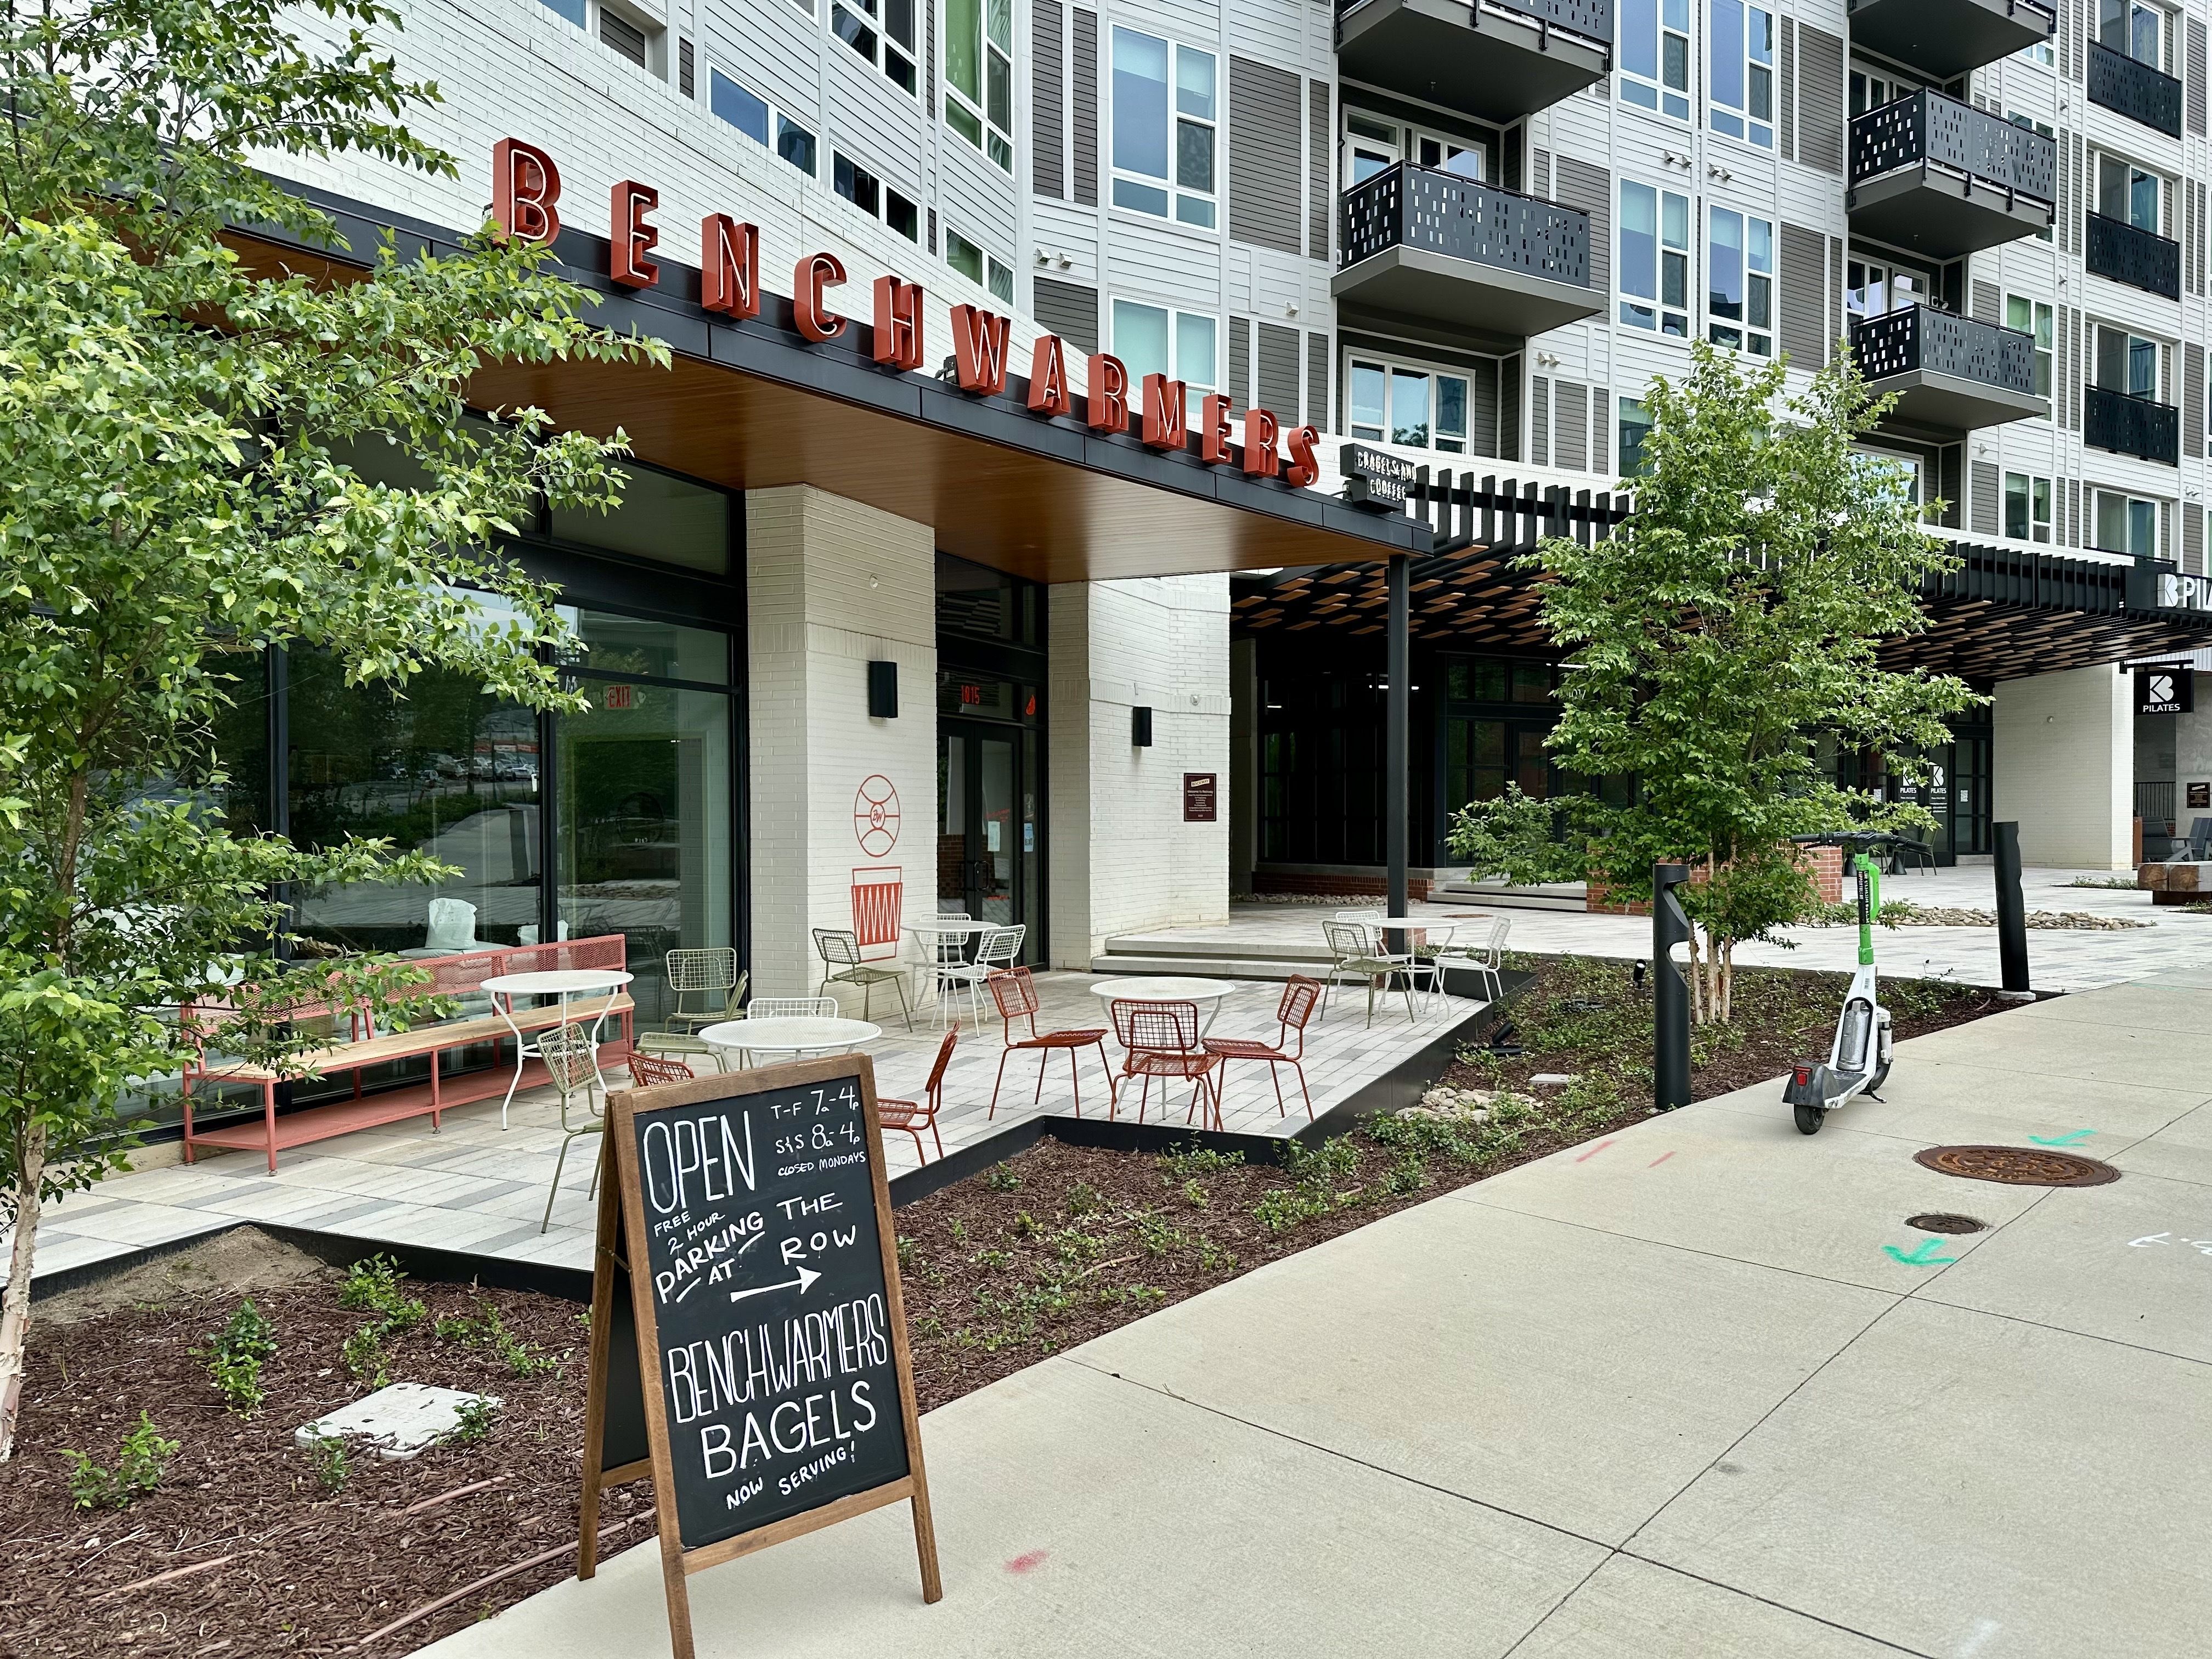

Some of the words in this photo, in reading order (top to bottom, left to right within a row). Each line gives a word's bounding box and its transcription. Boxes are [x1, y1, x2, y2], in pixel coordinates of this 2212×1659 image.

[493, 137, 1319, 488] BENCHWARMERS
[1370, 478, 1406, 501] COFFEE
[608, 685, 631, 708] EXIT
[961, 685, 980, 704] 1015
[2143, 703, 2180, 713] PILATES
[770, 1102, 802, 1119] T-F
[775, 1134, 805, 1154] S&S
[644, 1110, 755, 1214] OPEN
[777, 1162, 815, 1176] CLOSED
[819, 1151, 866, 1172] MONDAYS
[653, 1211, 691, 1237] FREE
[667, 1237, 684, 1255] 2
[687, 1212, 726, 1241] HOUR
[655, 1211, 764, 1304] PARKING
[776, 1192, 843, 1220] THE
[708, 1258, 736, 1285] AT
[780, 1224, 856, 1266] ROW
[667, 1293, 888, 1424] BENCHWARMERS
[701, 1380, 877, 1479] BAGELS
[726, 1476, 764, 1510] NOW
[777, 1440, 856, 1496] SERVING!
